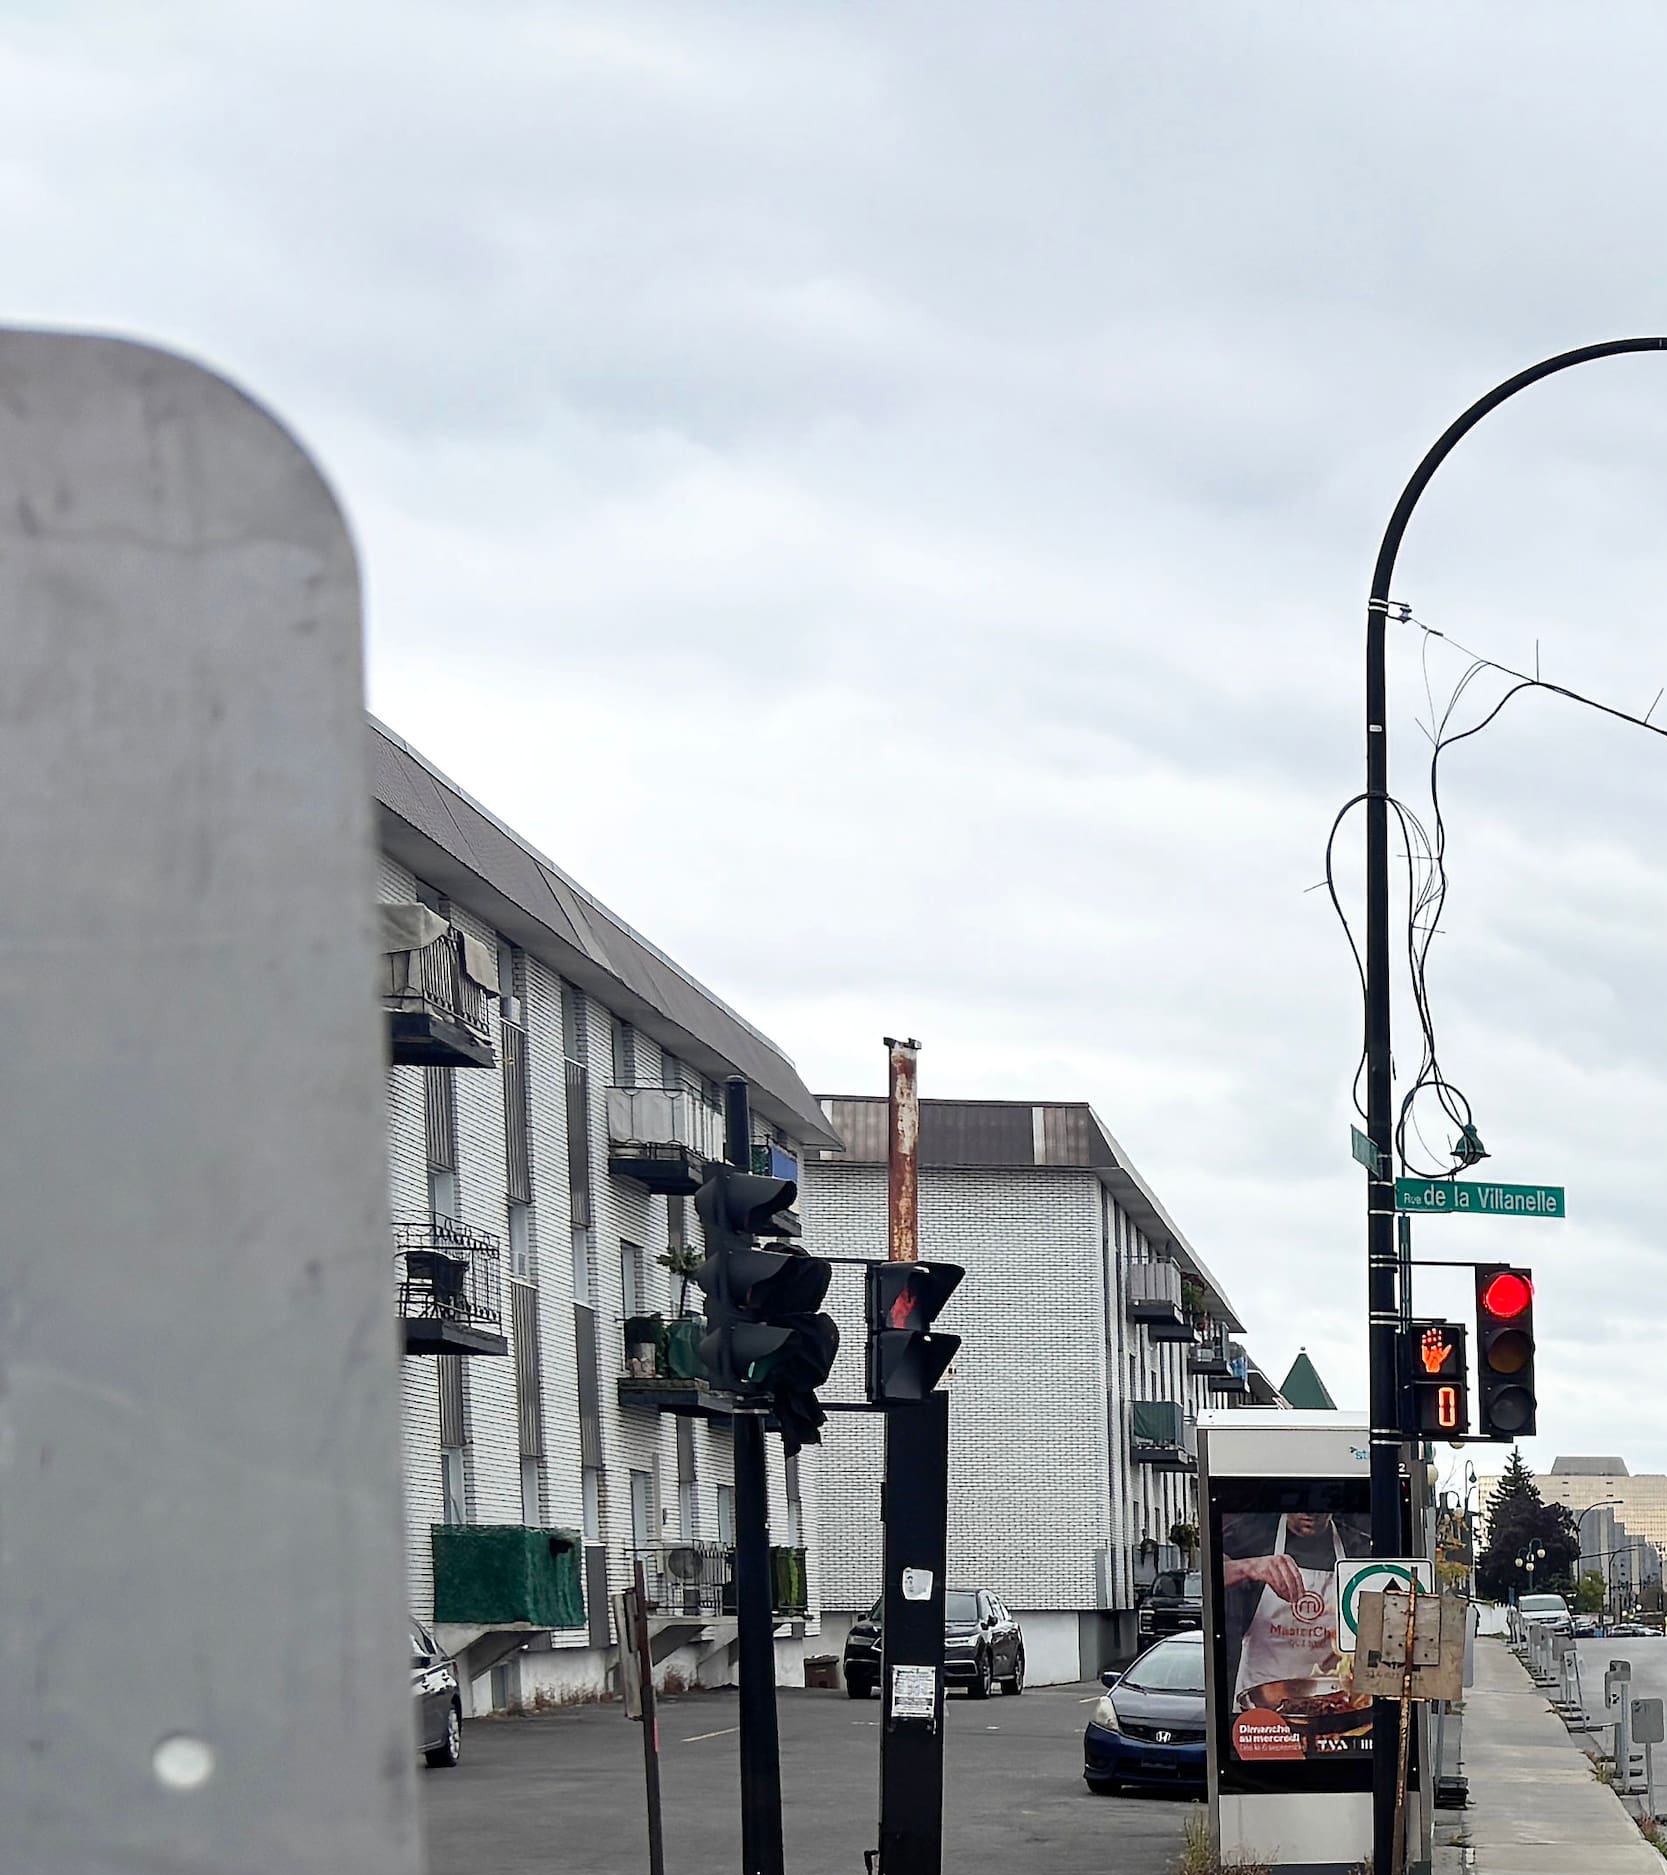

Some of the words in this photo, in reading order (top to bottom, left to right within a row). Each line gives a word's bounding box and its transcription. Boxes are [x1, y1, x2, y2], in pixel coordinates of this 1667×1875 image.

[1404, 1192, 1422, 1205] Rue
[1424, 1184, 1446, 1206] de
[1454, 1186, 1469, 1207] la
[1478, 1187, 1556, 1212] Villanelle
[1318, 1739, 1348, 1750] TVA
